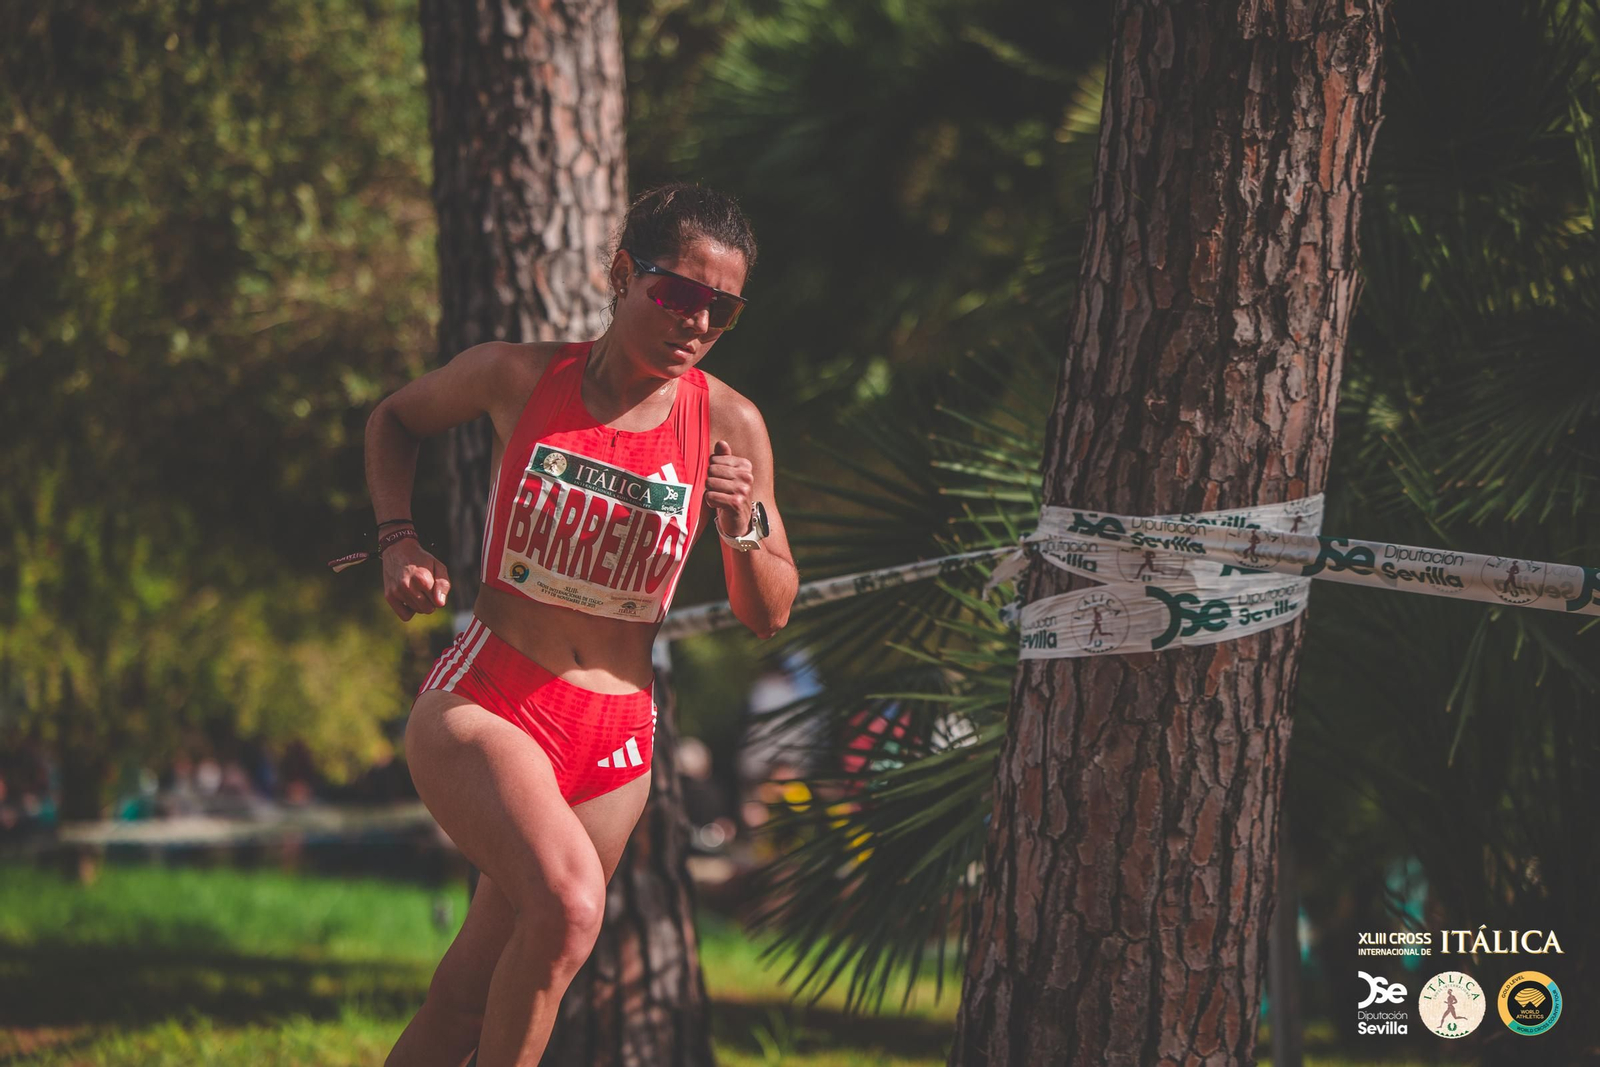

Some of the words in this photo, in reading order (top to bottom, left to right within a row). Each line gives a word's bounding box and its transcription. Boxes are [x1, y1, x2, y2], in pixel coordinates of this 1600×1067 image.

[575, 464, 652, 504] ITÁLICA
[507, 474, 680, 594] BARREIRO
[1130, 532, 1206, 554] Sevilla
[1384, 545, 1464, 566] Diputación
[1382, 562, 1464, 588] Sevilla
[1238, 599, 1299, 626] Sevilla
